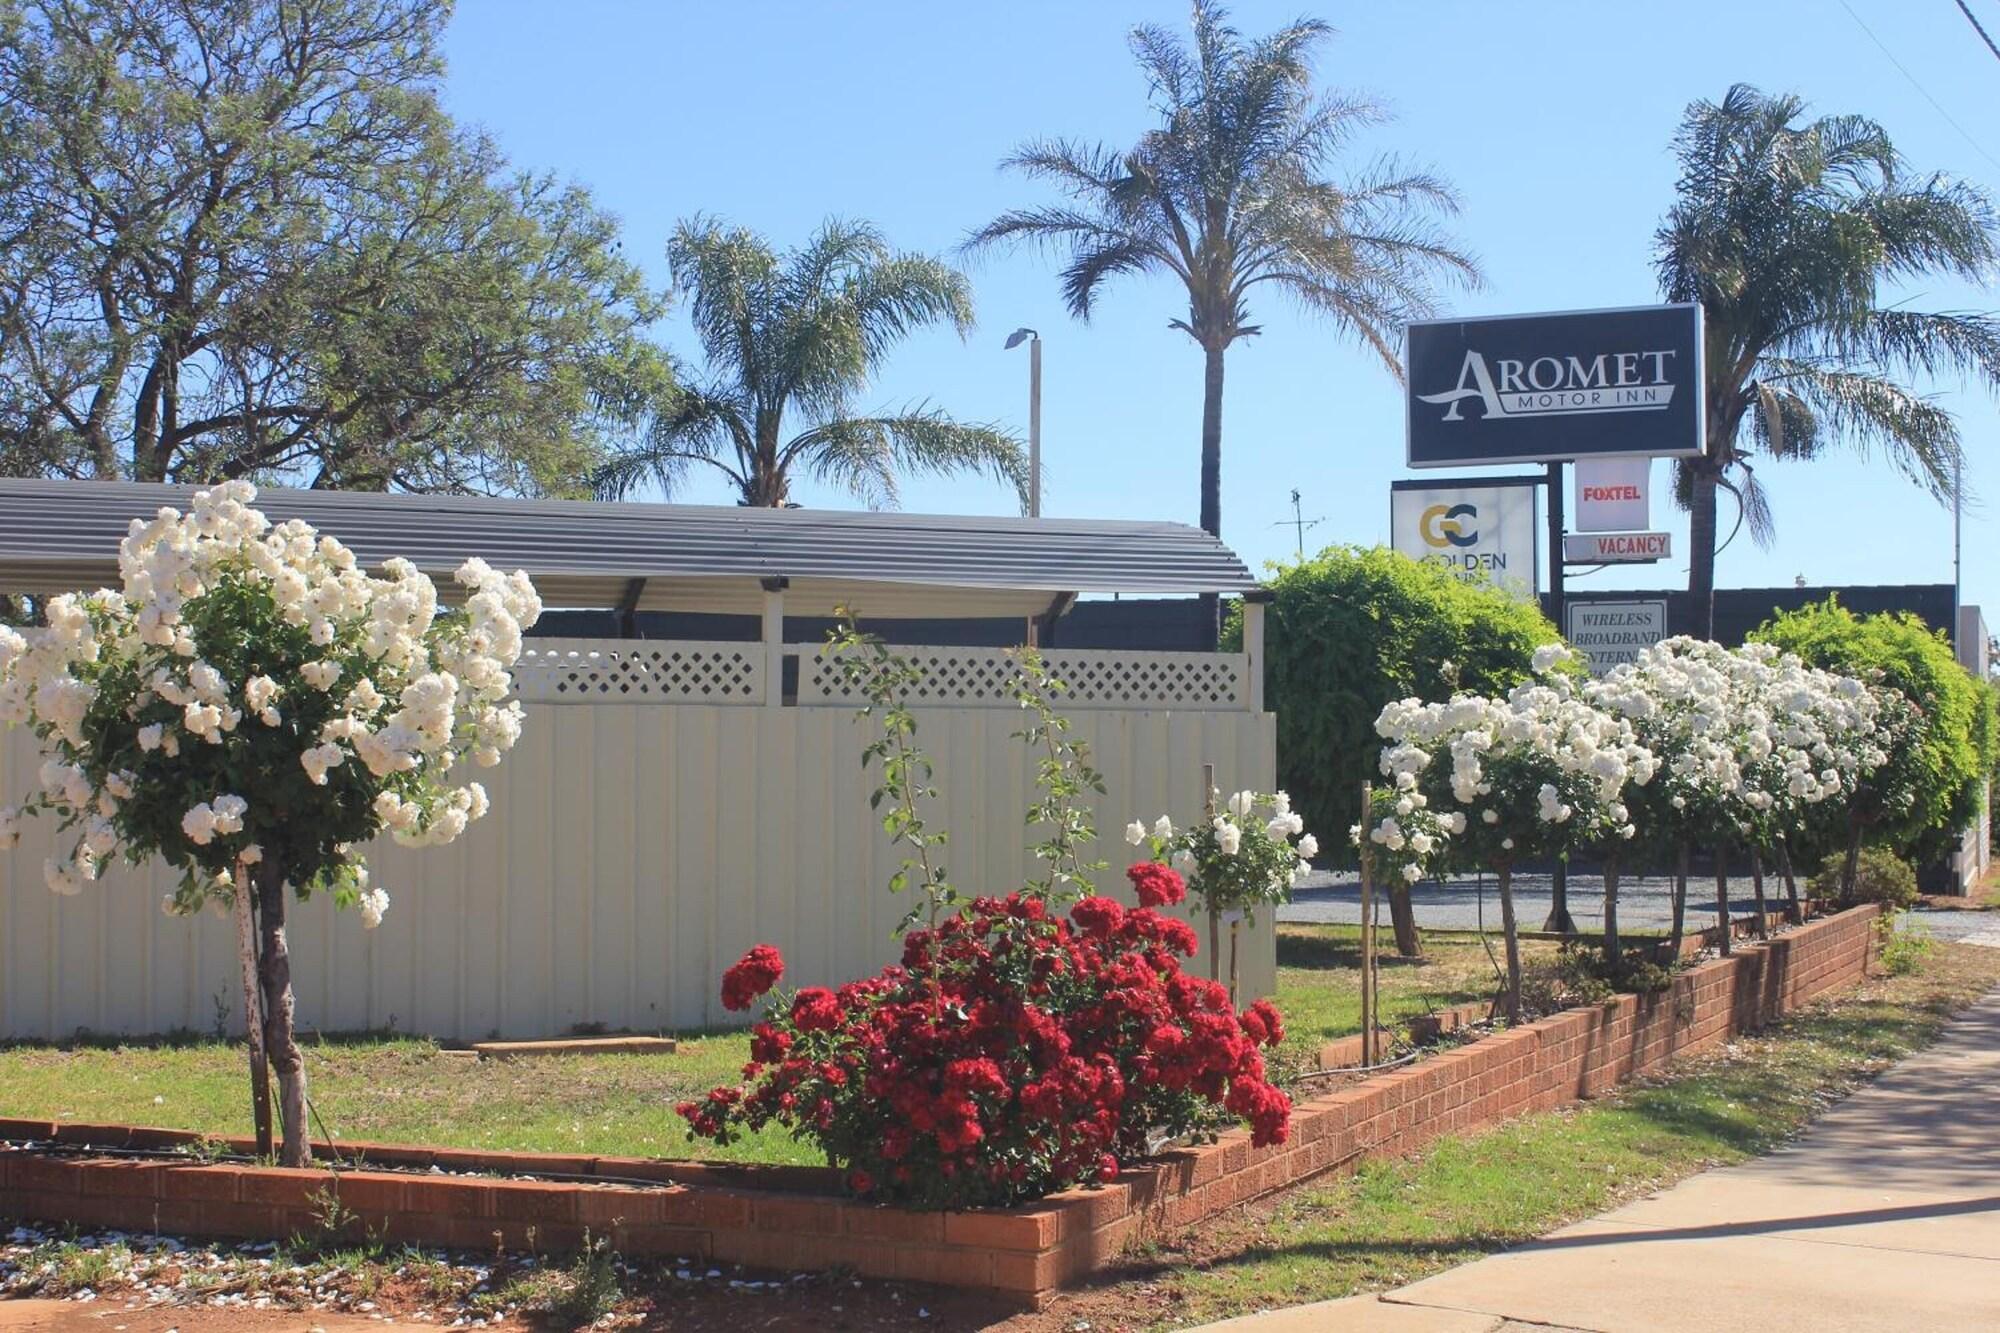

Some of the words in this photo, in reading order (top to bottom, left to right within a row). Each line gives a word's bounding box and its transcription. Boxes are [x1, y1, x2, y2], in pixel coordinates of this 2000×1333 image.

[1416, 350, 1676, 421] AROMET
[1518, 394, 1601, 408] MOTOR
[1616, 389, 1656, 403] INN
[1583, 486, 1640, 501] FOXTEL
[1599, 536, 1666, 554] VACANCY
[1582, 613, 1652, 627] WIRELESS
[1575, 632, 1661, 645] BROADBAND
